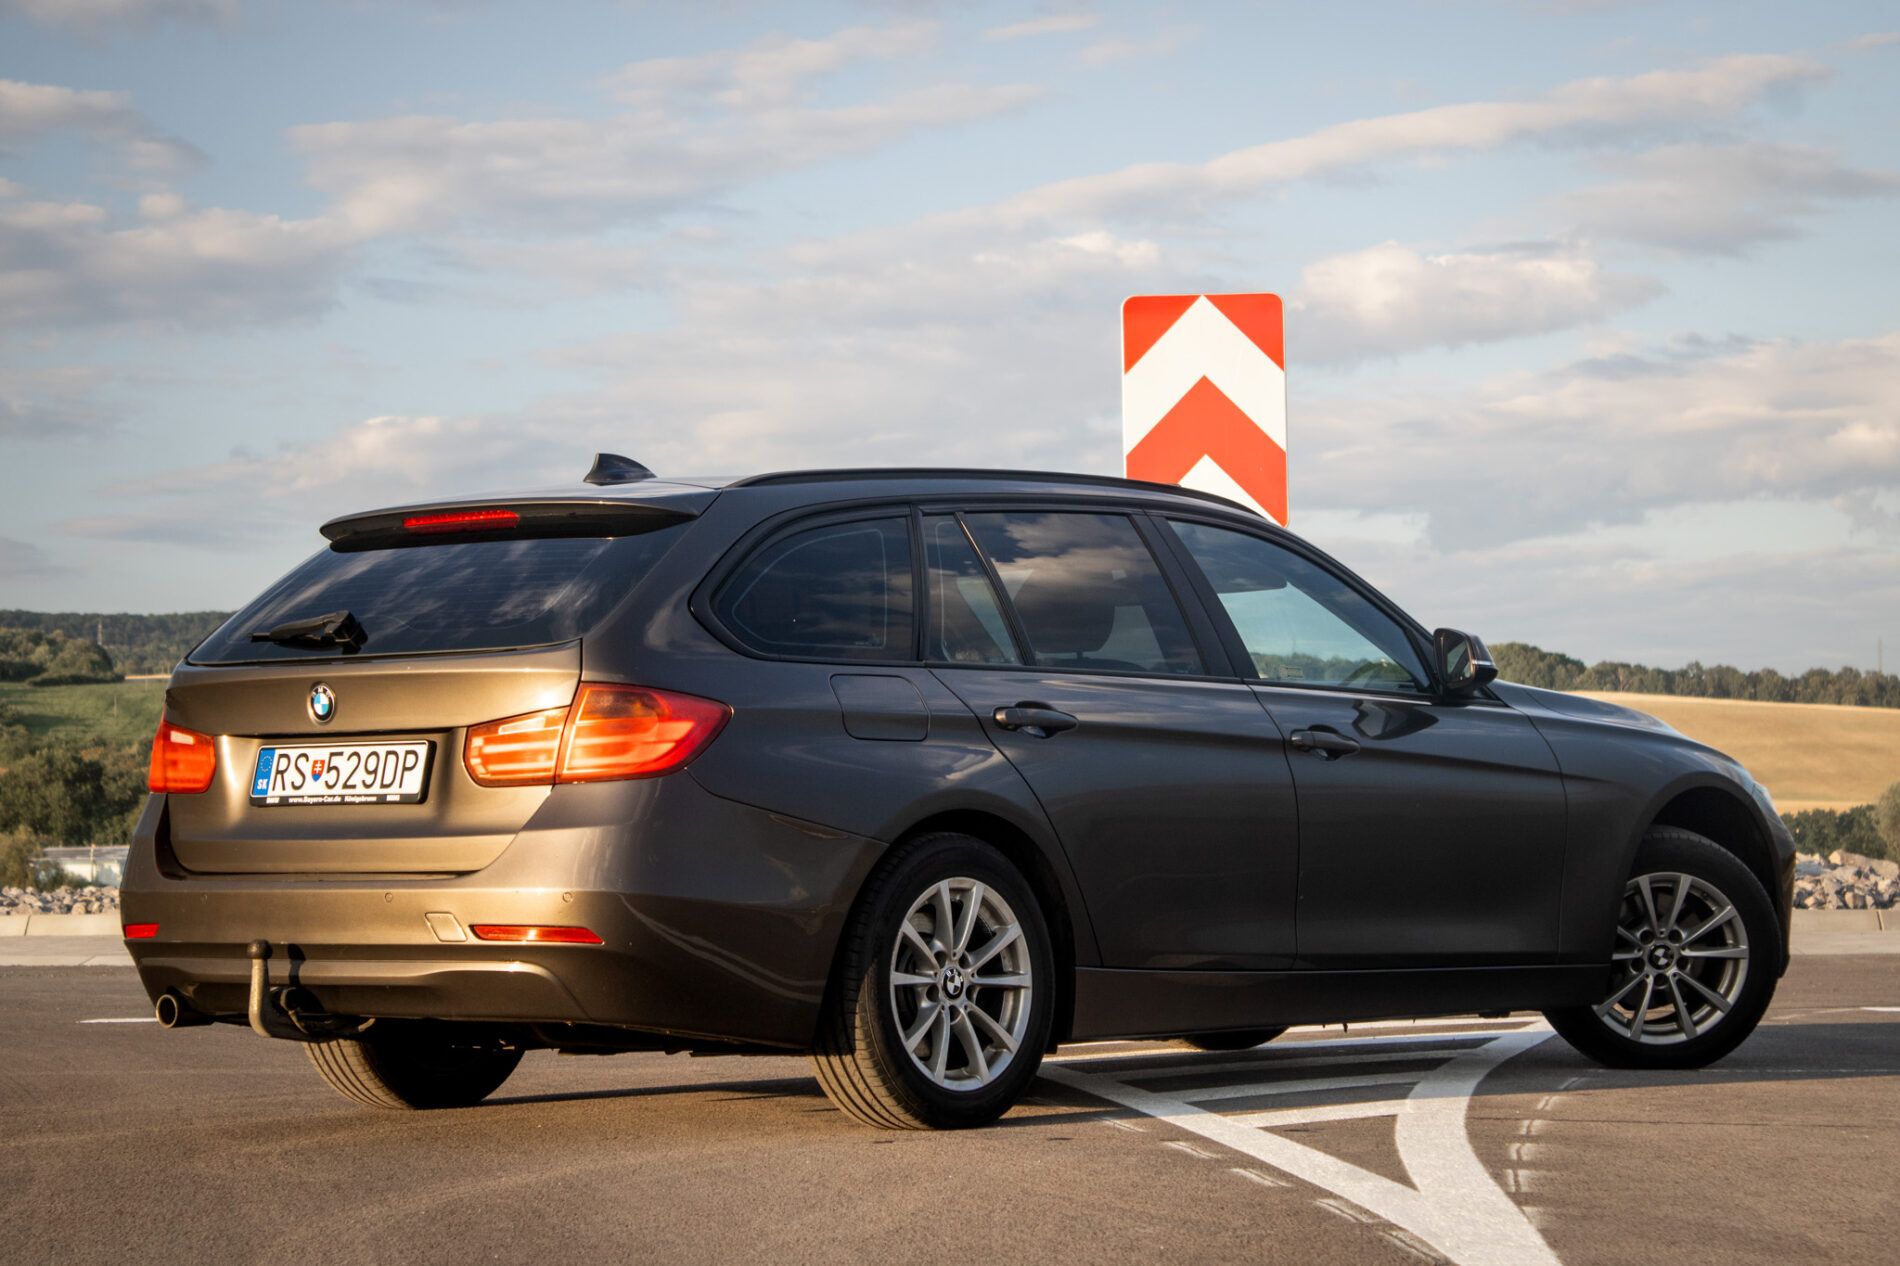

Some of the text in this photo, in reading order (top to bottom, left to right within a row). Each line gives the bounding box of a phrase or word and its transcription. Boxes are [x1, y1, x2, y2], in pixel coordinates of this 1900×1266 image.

[272, 749, 419, 791] RS 529DP
[257, 779, 268, 790] SK
